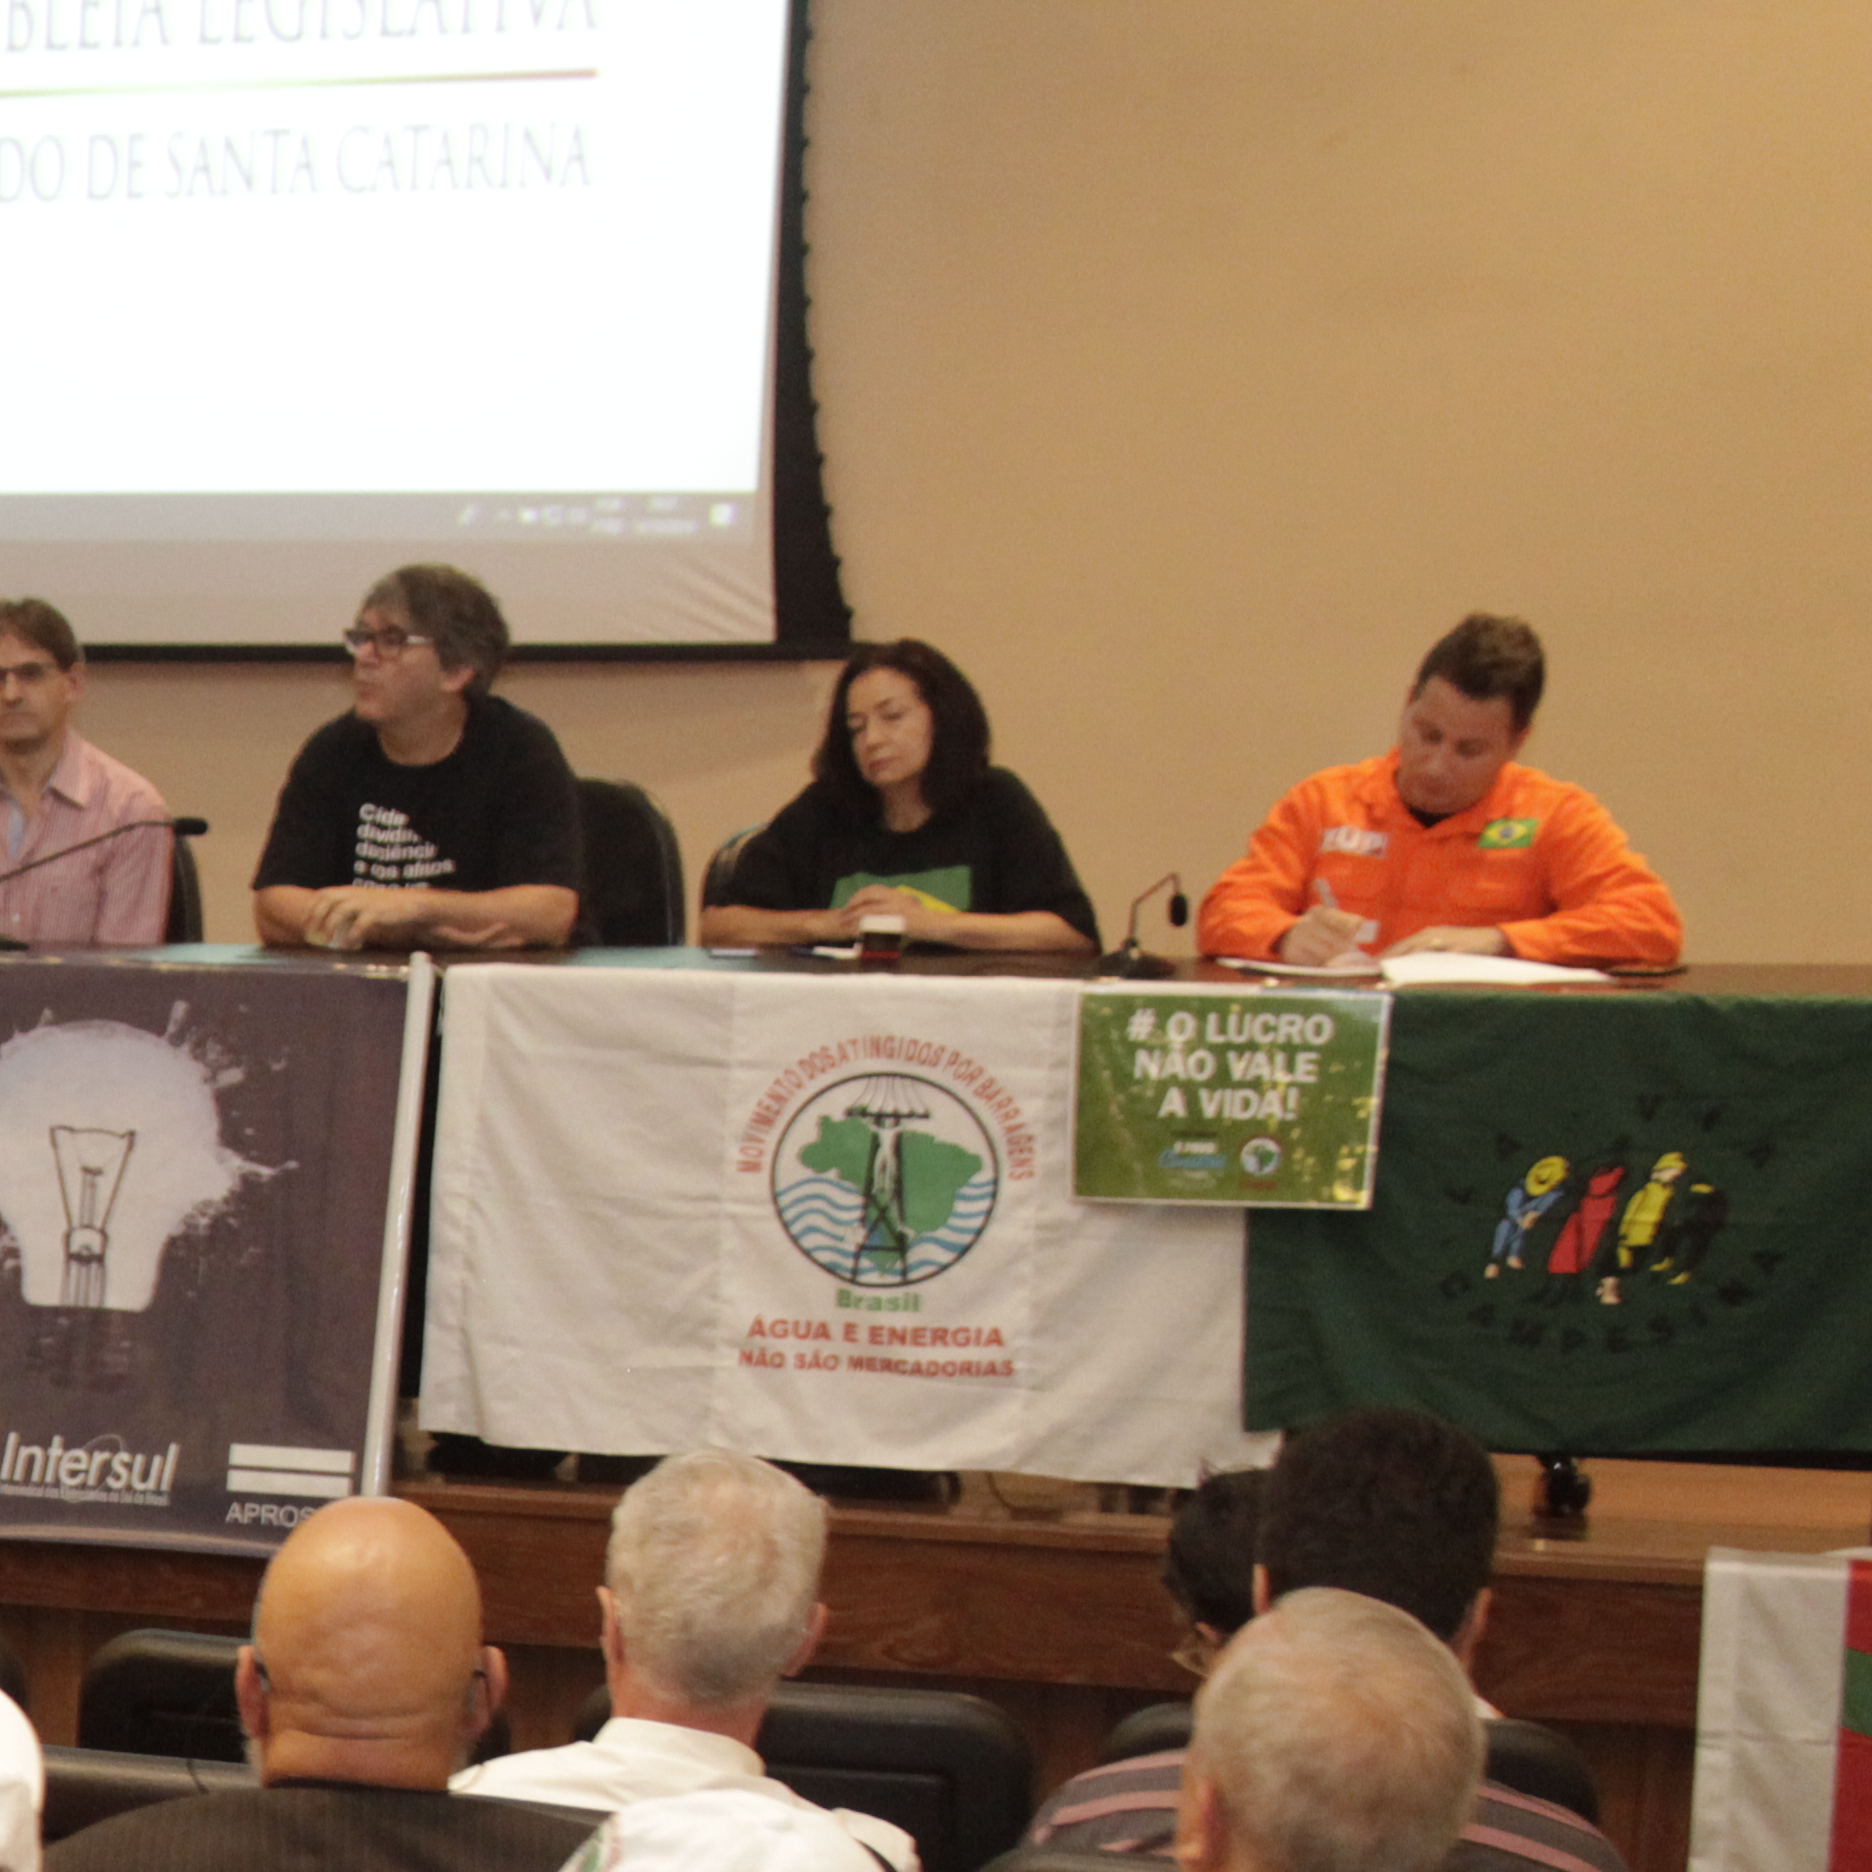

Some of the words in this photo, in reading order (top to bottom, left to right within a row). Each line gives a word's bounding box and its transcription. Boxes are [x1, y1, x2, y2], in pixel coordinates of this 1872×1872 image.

[86, 133, 147, 201] DE
[165, 127, 320, 199] SANTA
[335, 121, 596, 194] CATARINA
[1166, 1010, 1198, 1042] O
[1205, 1012, 1336, 1046] LUCRO
[1133, 1043, 1217, 1081] NÃO
[1226, 1050, 1323, 1083] VALE
[942, 1050, 985, 1087] POR
[972, 1077, 1036, 1181] BARRAGENS
[1157, 1087, 1190, 1119] A
[1198, 1087, 1300, 1120] VIDA!
[836, 1288, 925, 1313] Brasil
[745, 1313, 833, 1341] ÁGUA
[842, 1322, 861, 1343] E
[867, 1325, 1005, 1348] ENERGIA
[736, 1346, 786, 1370] NÃO
[794, 1346, 838, 1371] SÃO
[845, 1354, 1015, 1378] MERCADORIAS
[0, 1431, 182, 1492] Intersul
